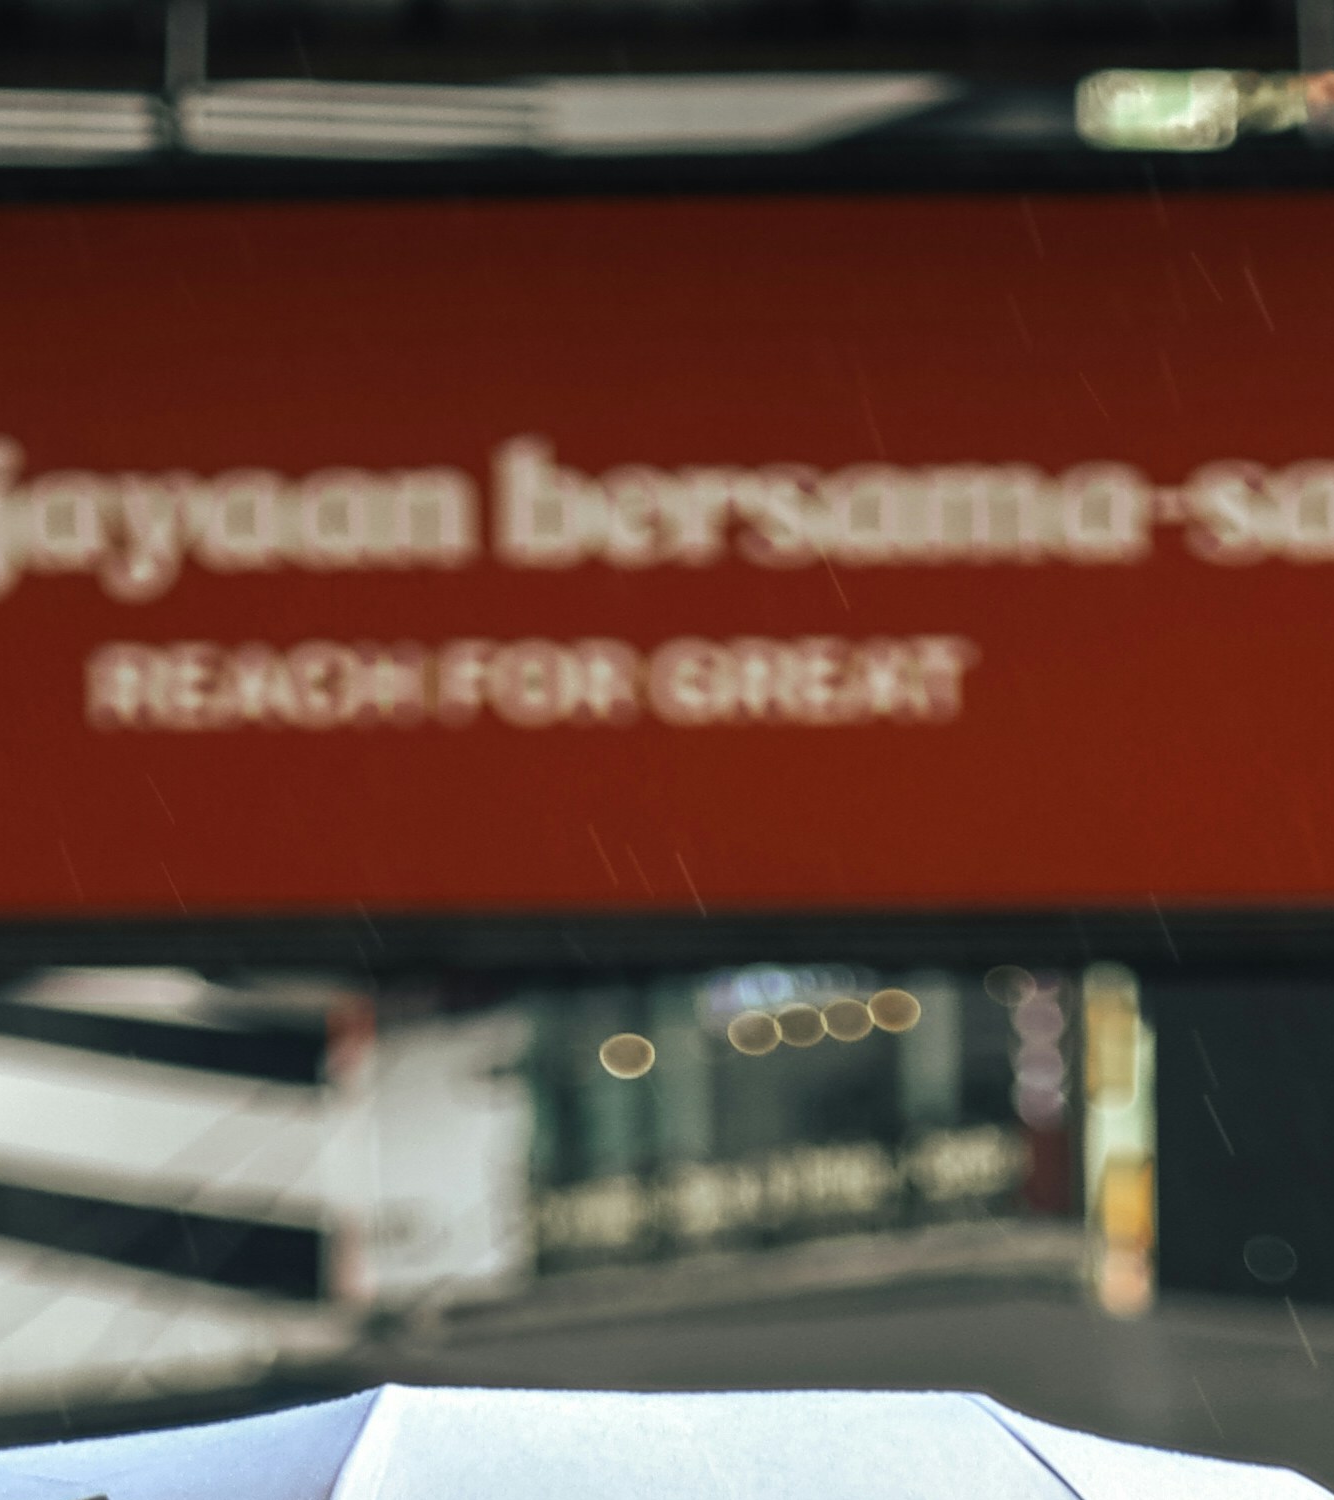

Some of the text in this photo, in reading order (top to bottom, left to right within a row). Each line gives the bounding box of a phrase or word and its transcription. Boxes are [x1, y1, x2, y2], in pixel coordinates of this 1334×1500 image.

[87, 634, 973, 729] REACH FOR GREAT
